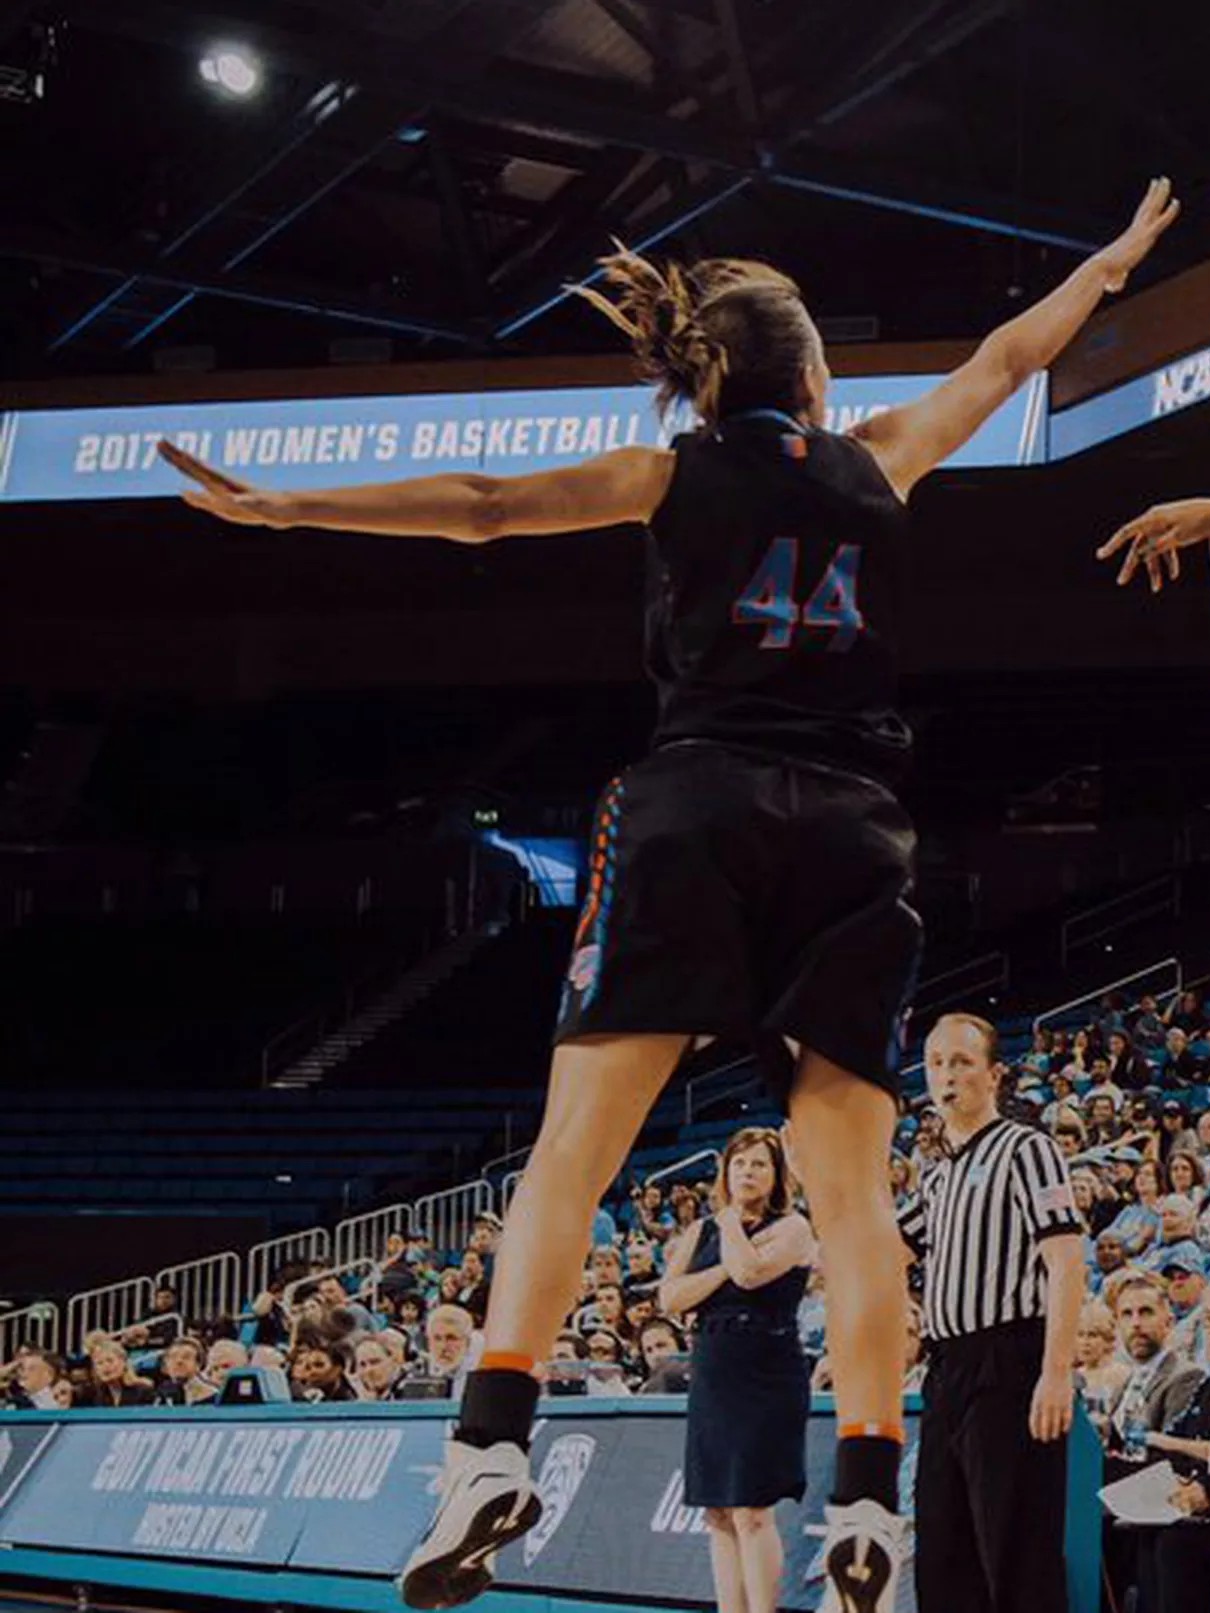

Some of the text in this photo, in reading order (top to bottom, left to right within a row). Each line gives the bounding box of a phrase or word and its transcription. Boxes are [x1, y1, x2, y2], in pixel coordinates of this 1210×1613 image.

[74, 431, 163, 473] 2017
[223, 423, 399, 467] WOMEN'S
[411, 414, 640, 459] BASKETBALL
[732, 536, 864, 651] 44
[205, 1429, 306, 1495] FIRST
[283, 1428, 405, 1499] ROUND
